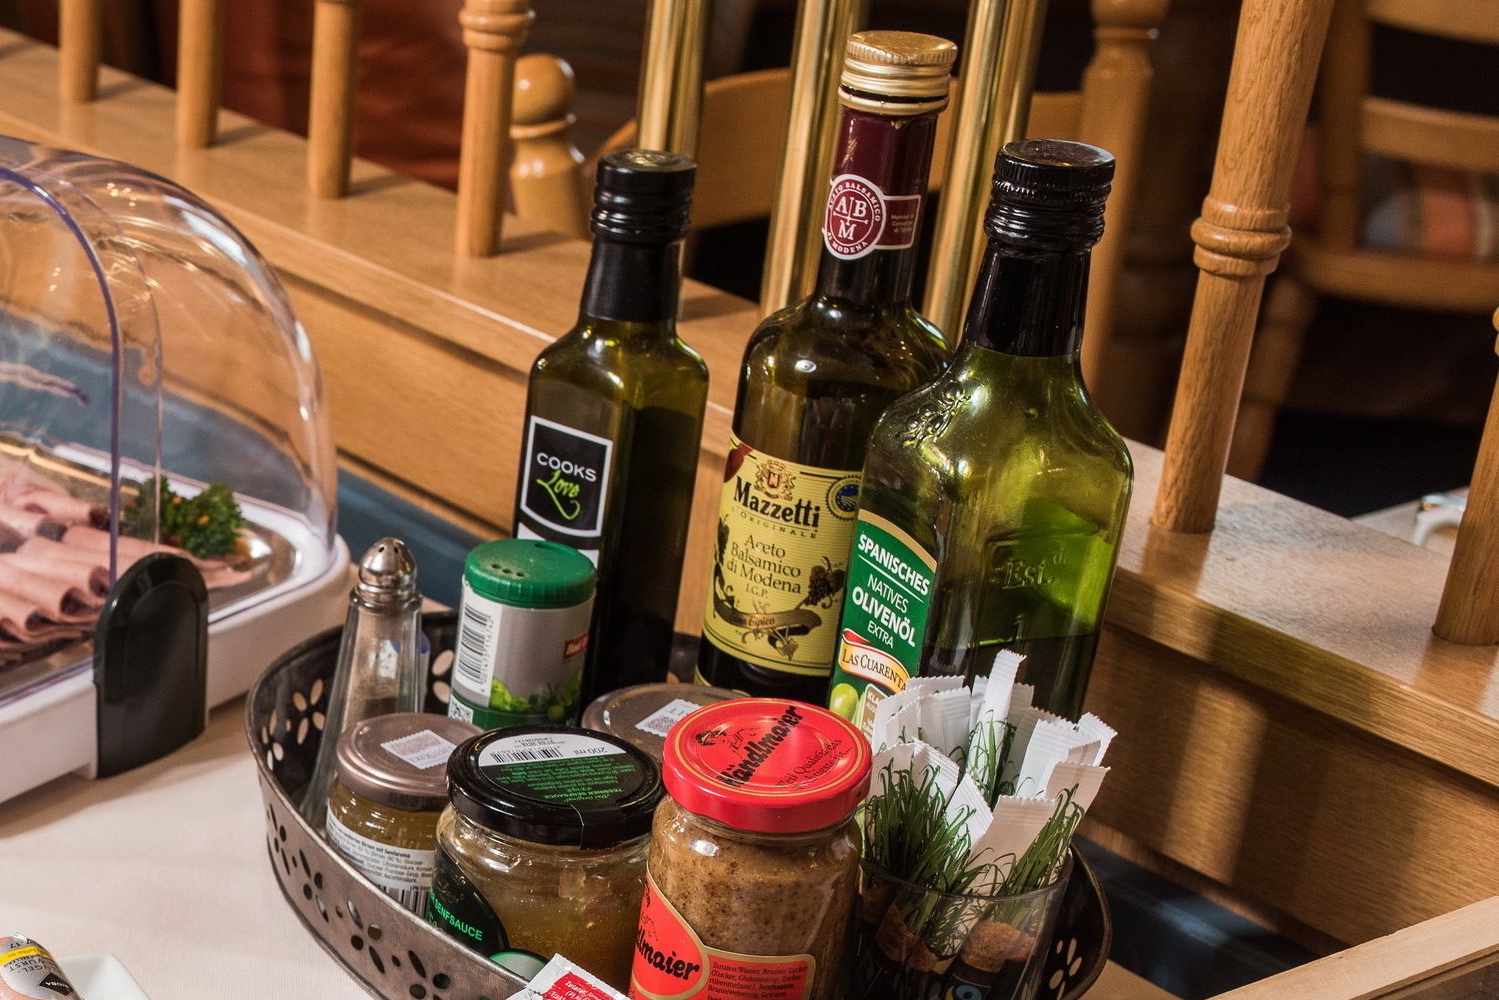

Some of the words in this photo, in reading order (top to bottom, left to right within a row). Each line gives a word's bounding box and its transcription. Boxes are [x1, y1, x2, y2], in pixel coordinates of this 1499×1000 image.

[845, 182, 881, 222] BALSAMICO
[832, 240, 868, 254] MODENA
[537, 452, 597, 482] COOKS
[536, 470, 580, 520] Love
[734, 476, 821, 528] Mazzetti
[730, 541, 801, 578] Balsamico
[744, 534, 786, 559] Aceto
[858, 533, 931, 597] SPANISCHES
[727, 560, 738, 575] di
[739, 567, 802, 595] Modena
[868, 574, 909, 613] NATIVES
[852, 586, 916, 648] OLIVENÖL
[867, 621, 894, 649] EXTRA
[435, 898, 484, 942] SENFSAUCE
